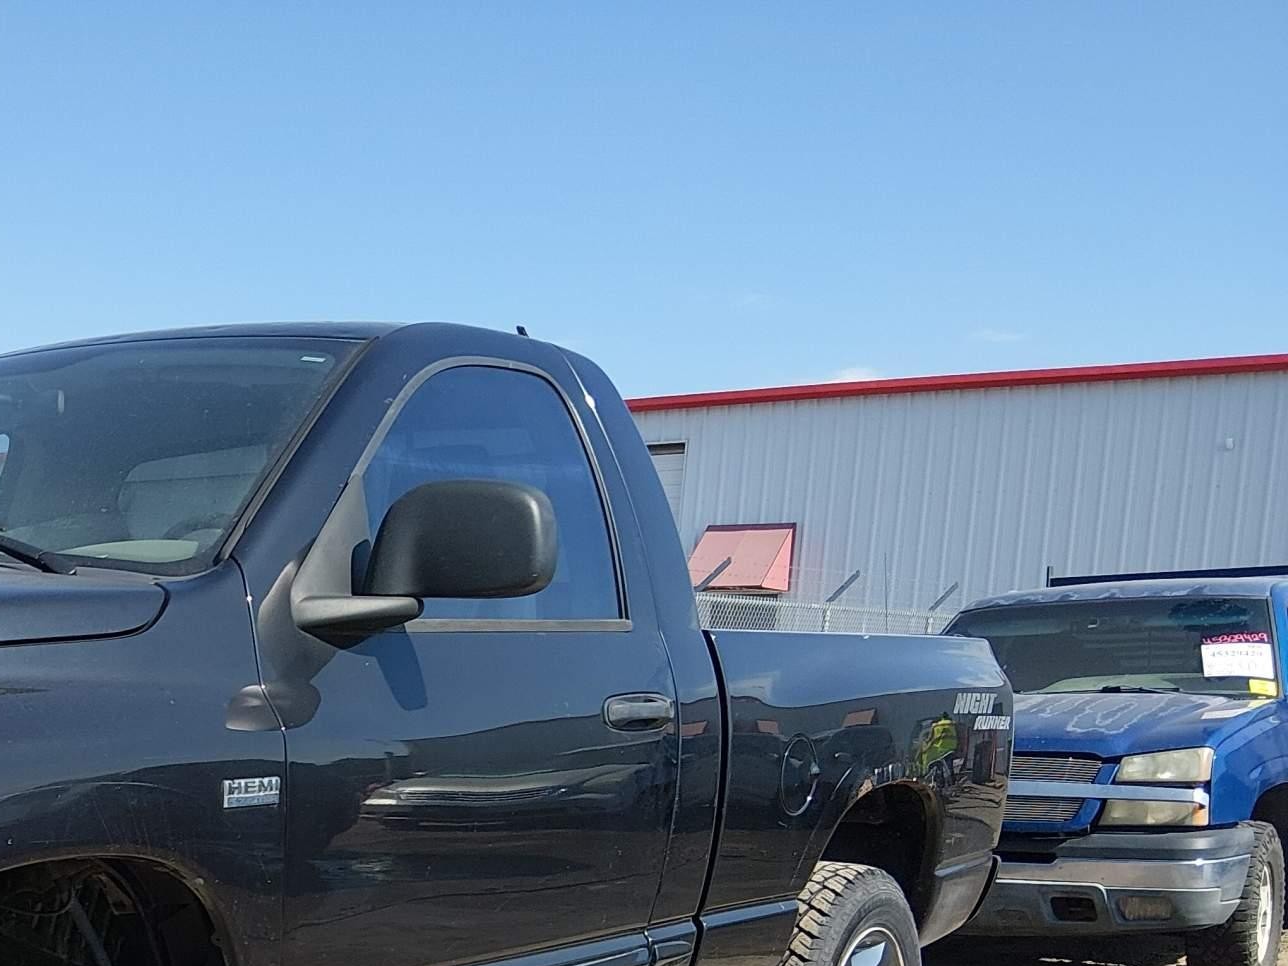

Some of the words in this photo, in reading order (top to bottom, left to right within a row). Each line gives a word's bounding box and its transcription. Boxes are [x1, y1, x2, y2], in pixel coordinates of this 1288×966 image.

[953, 692, 998, 714] NIGHT
[973, 715, 1011, 731] RUNNER
[226, 777, 280, 795] HEMI
